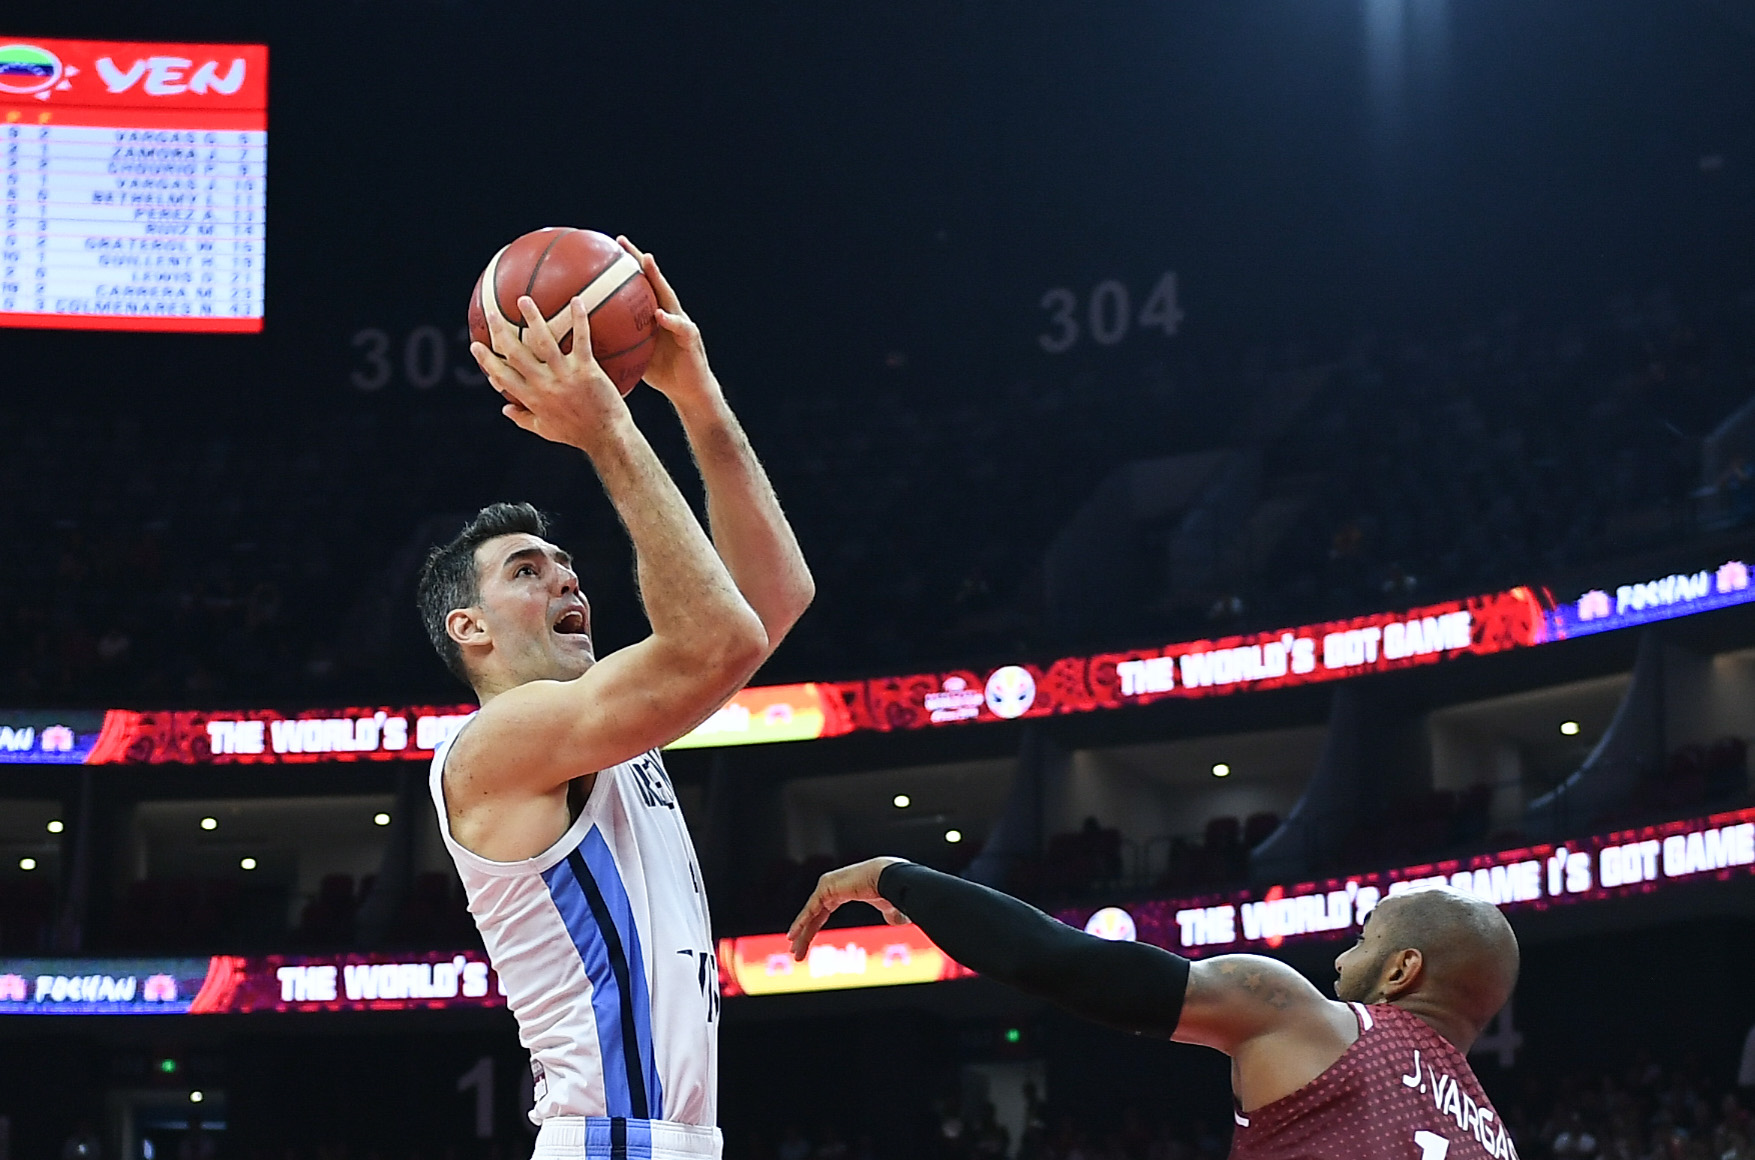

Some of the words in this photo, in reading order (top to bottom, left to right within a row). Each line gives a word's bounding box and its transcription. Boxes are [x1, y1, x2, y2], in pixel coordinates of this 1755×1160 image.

[95, 56, 246, 95] VEN
[1036, 270, 1185, 353] 304
[1118, 656, 1174, 696] THE
[1180, 634, 1314, 689] WORLD'S
[1323, 626, 1382, 669] GOT
[1384, 611, 1472, 662] GAME
[207, 719, 264, 755] THE
[272, 711, 407, 753] WORLD'S
[1175, 905, 1235, 946] THE
[1241, 881, 1380, 940] WORLD'S
[1600, 839, 1660, 887] GOT
[1663, 822, 1754, 877] GAME
[277, 965, 337, 1001] THE
[344, 955, 488, 1000] WORLD'S
